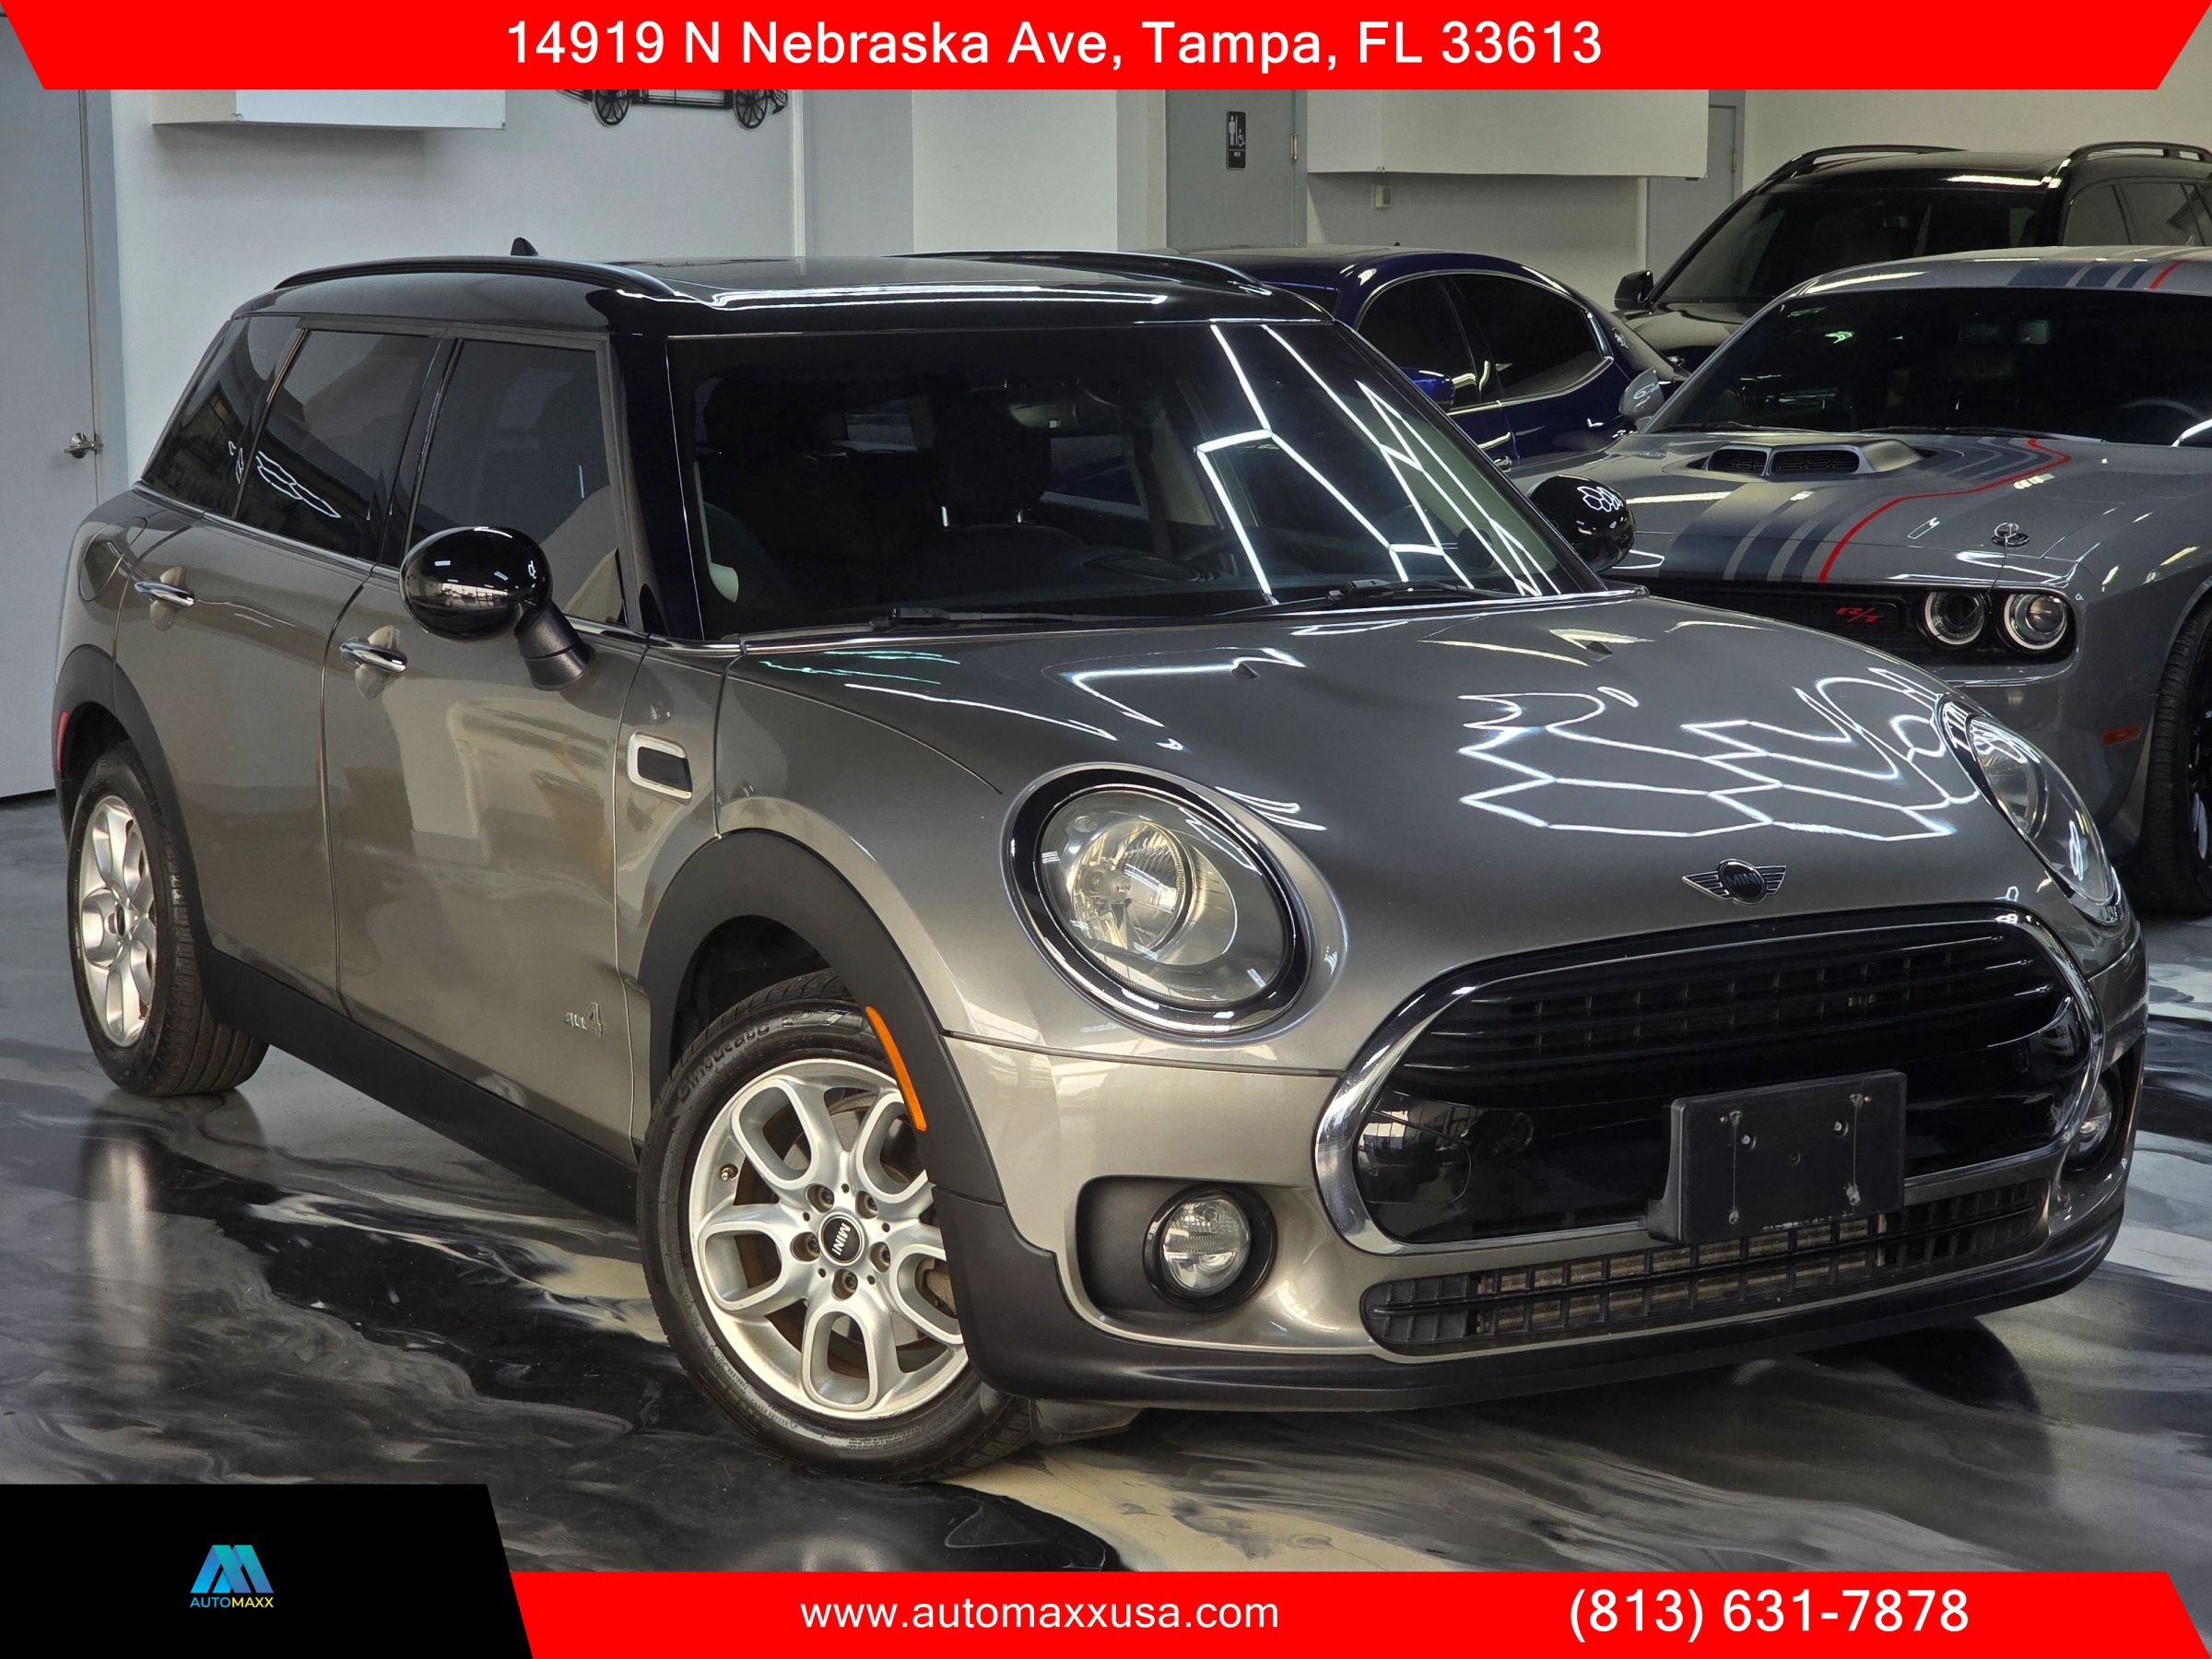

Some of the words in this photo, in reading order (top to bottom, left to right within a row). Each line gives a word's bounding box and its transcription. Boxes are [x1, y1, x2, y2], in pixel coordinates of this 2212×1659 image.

[1835, 606, 1884, 624] R/T
[1724, 872, 1761, 888] MINI
[831, 1222, 852, 1256] MINI
